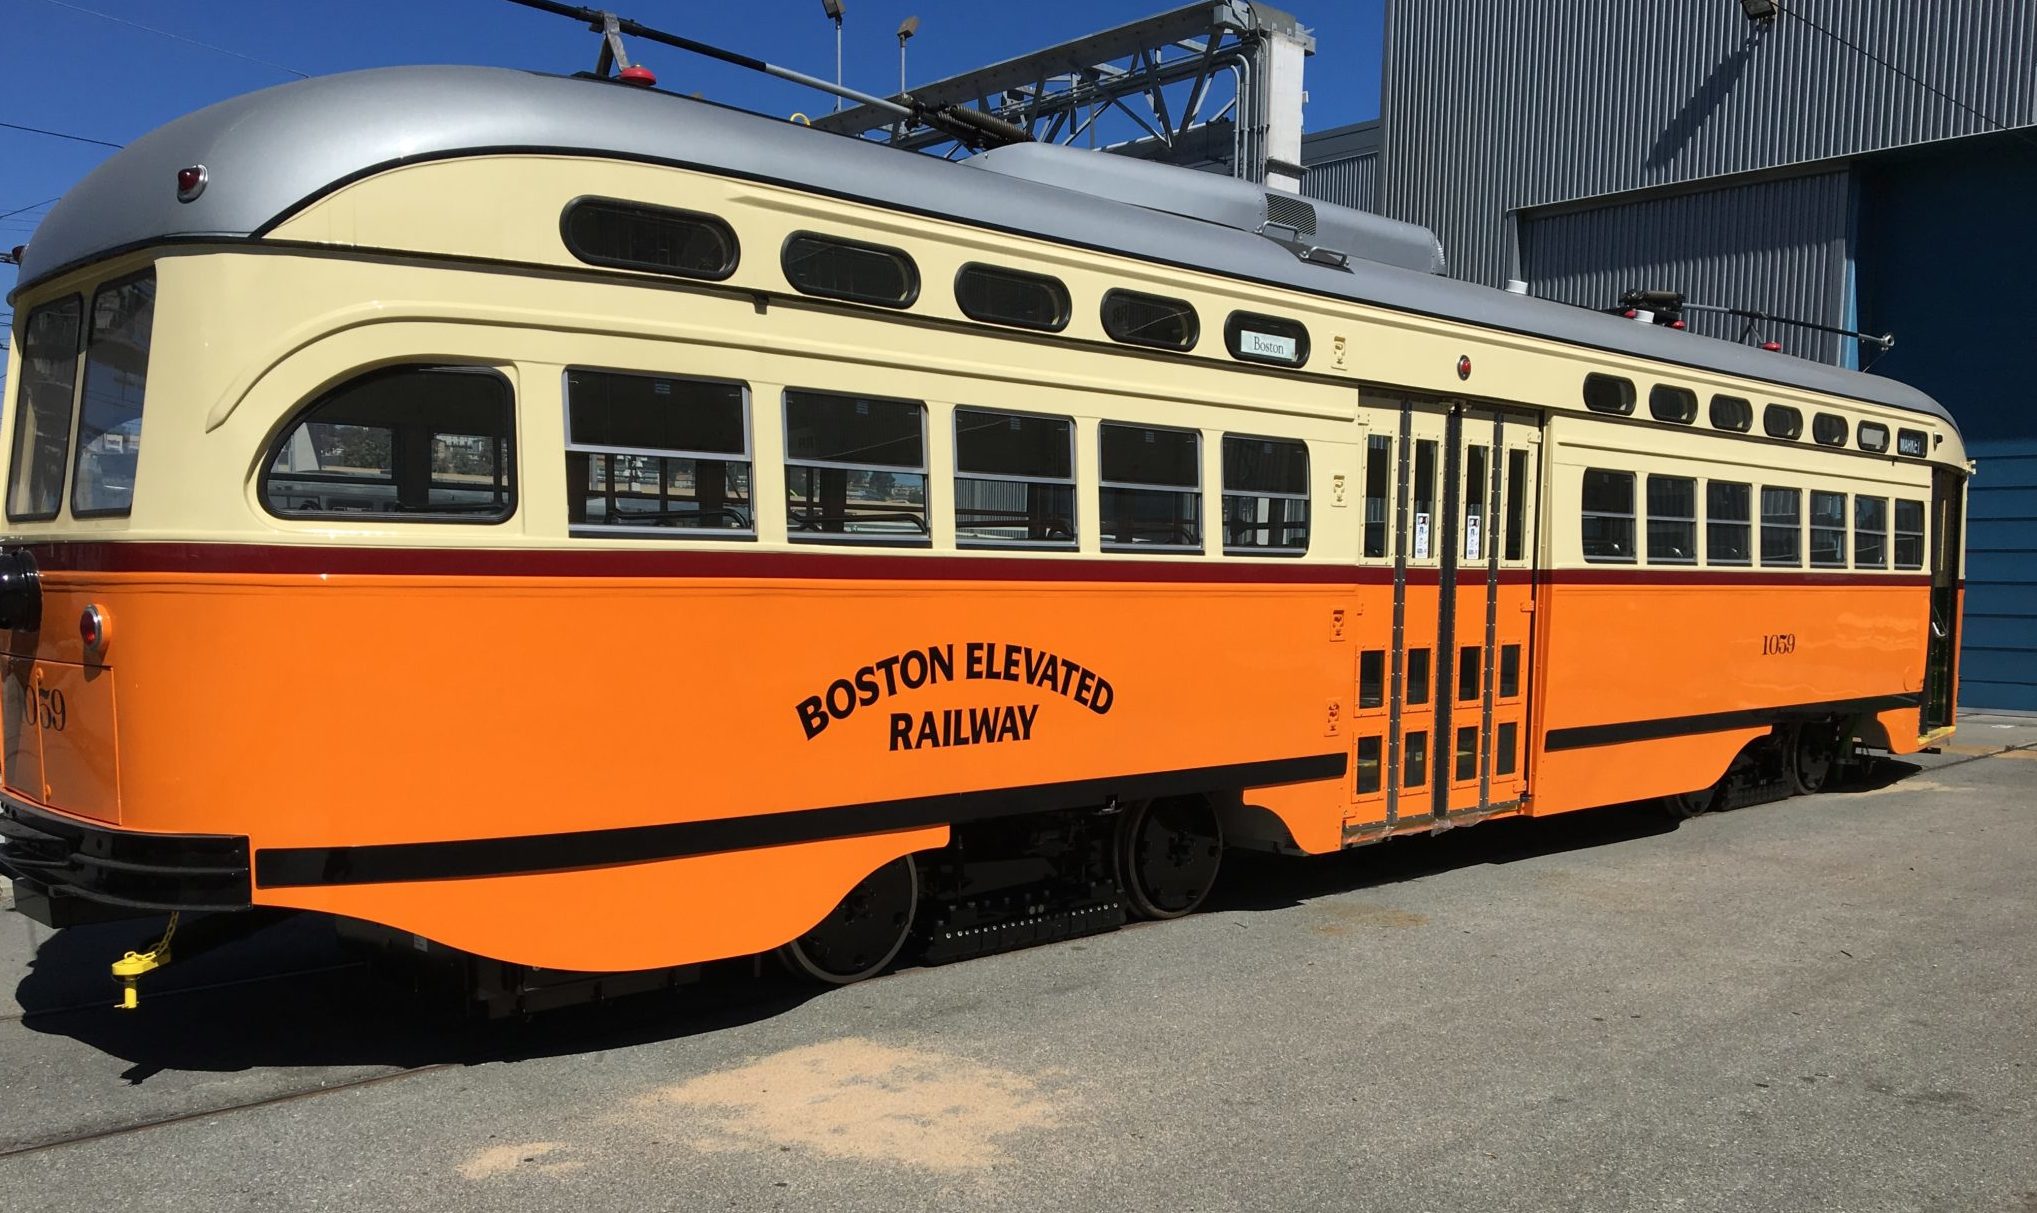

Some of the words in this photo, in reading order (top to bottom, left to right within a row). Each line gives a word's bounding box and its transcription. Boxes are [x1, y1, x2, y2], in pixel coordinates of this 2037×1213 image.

[1253, 336, 1284, 355] Boston
[1762, 633, 1795, 655] 1059
[25, 685, 65, 732] 059
[795, 643, 954, 741] BOSTON
[965, 642, 1114, 715] ELEVATED
[889, 704, 1040, 751] RAILWAY
